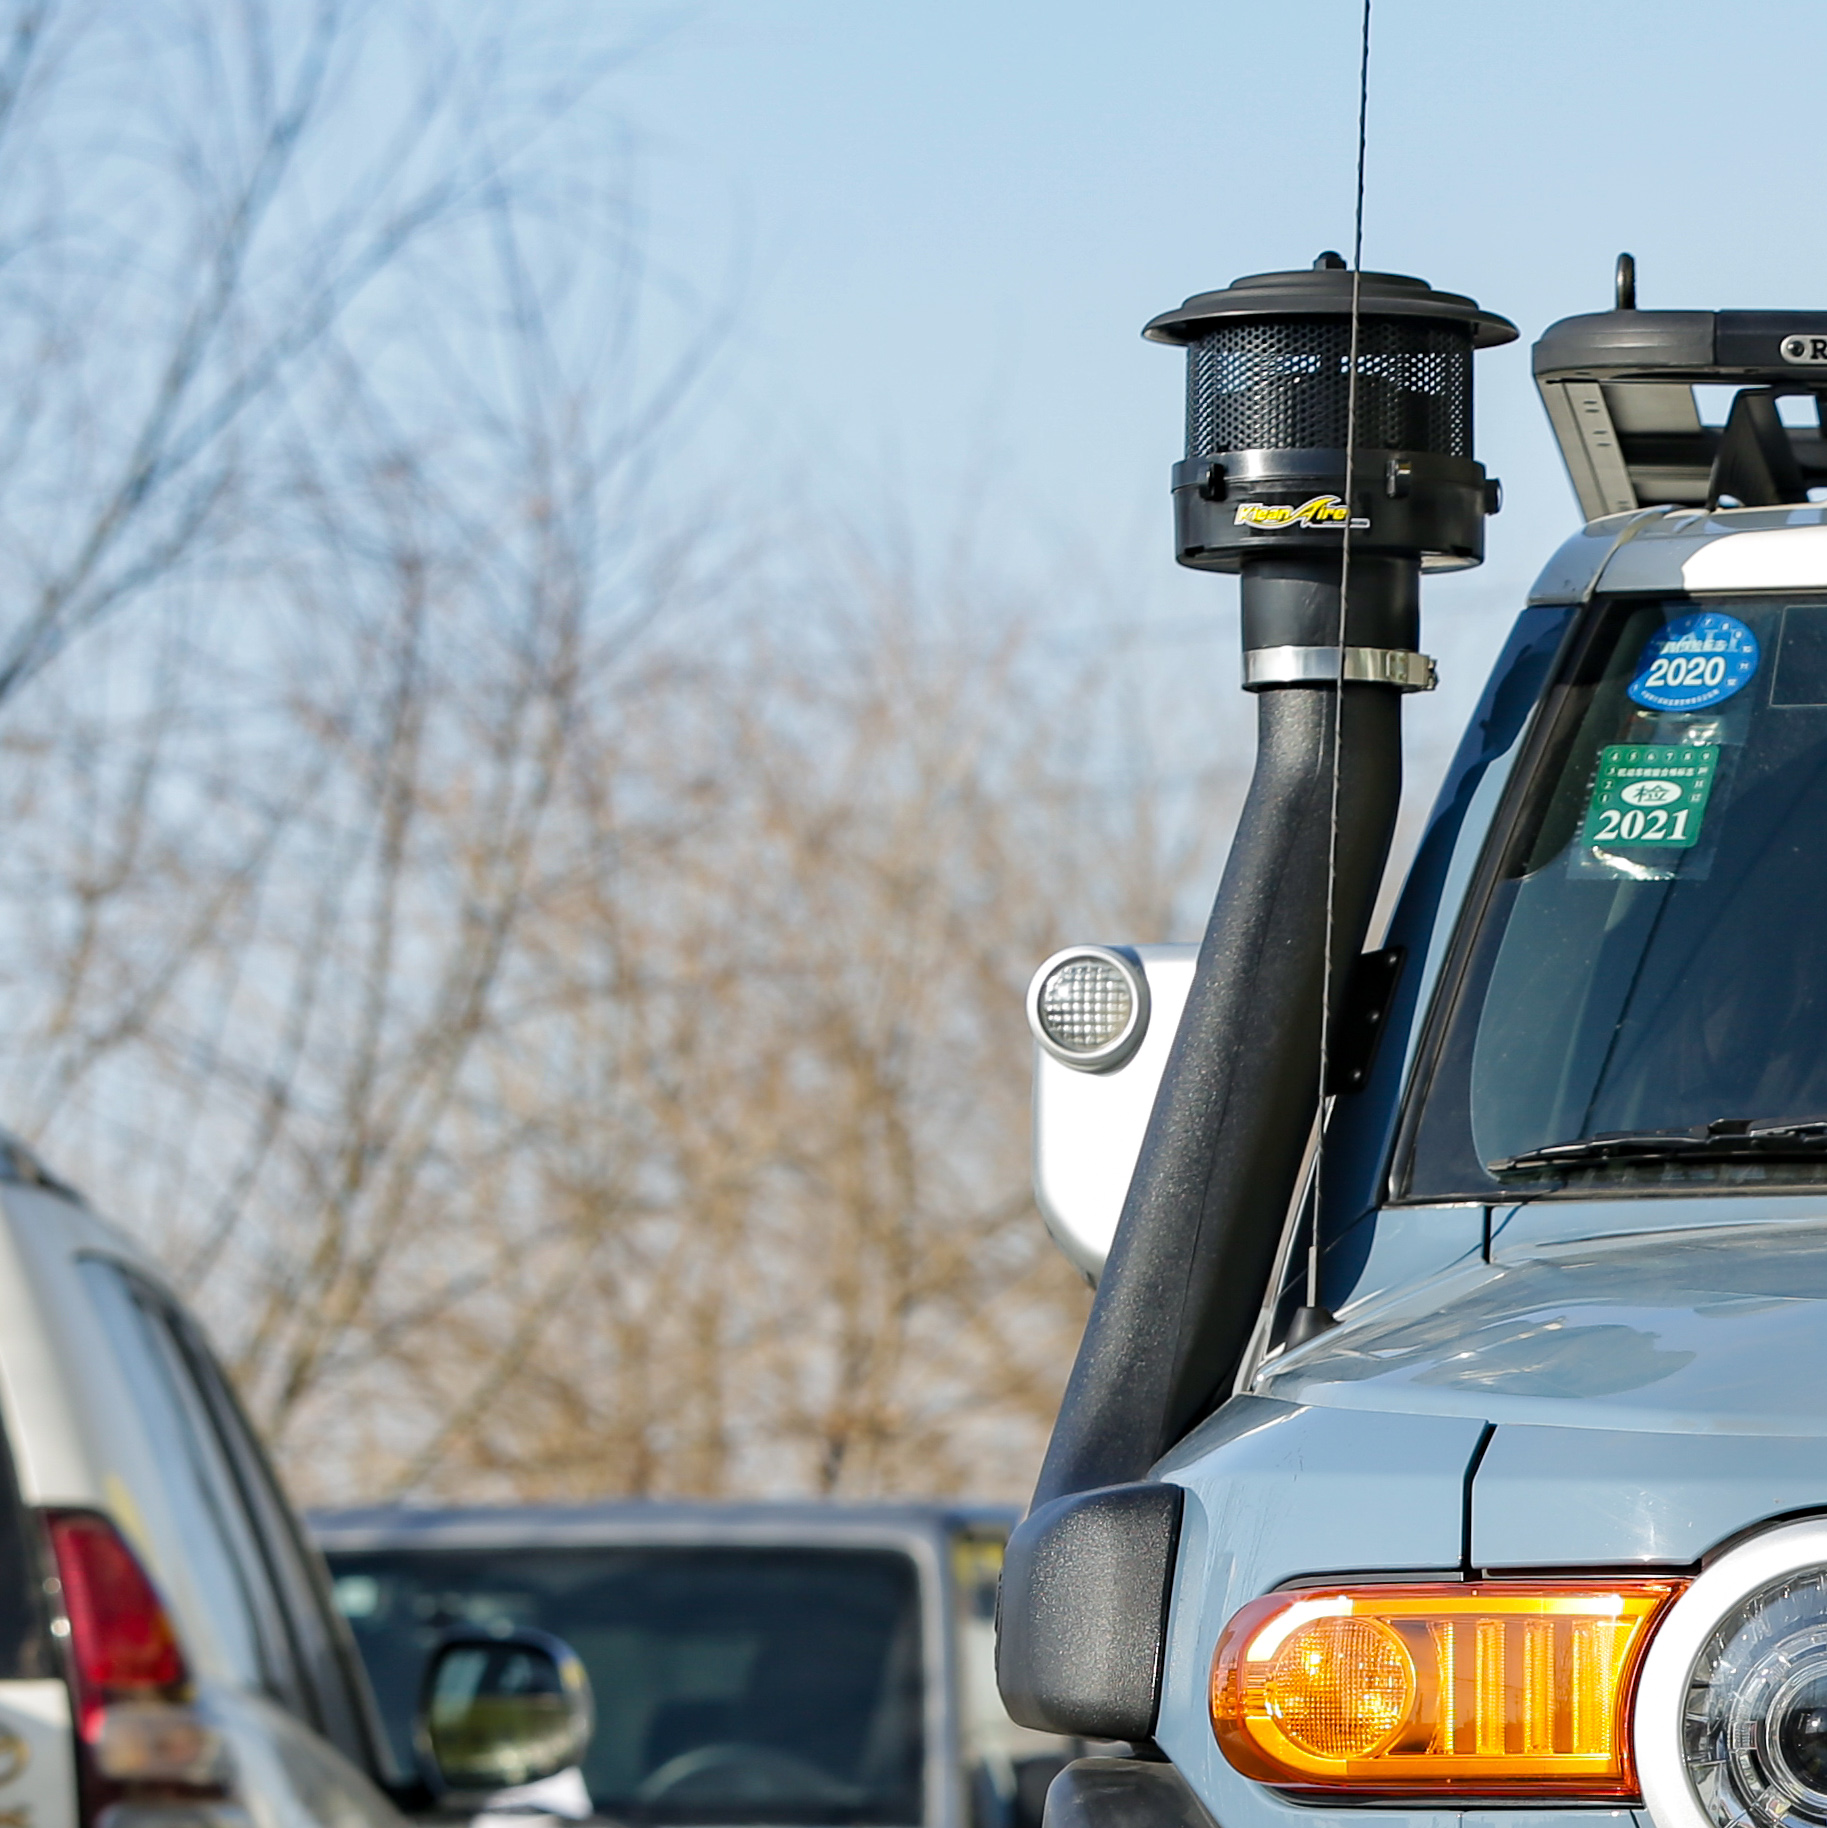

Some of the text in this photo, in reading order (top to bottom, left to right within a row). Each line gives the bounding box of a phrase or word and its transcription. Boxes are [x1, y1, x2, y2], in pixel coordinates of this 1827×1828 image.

[1645, 656, 1726, 687] 2020
[1632, 784, 1670, 803] 检
[1593, 808, 1689, 841] 2021
